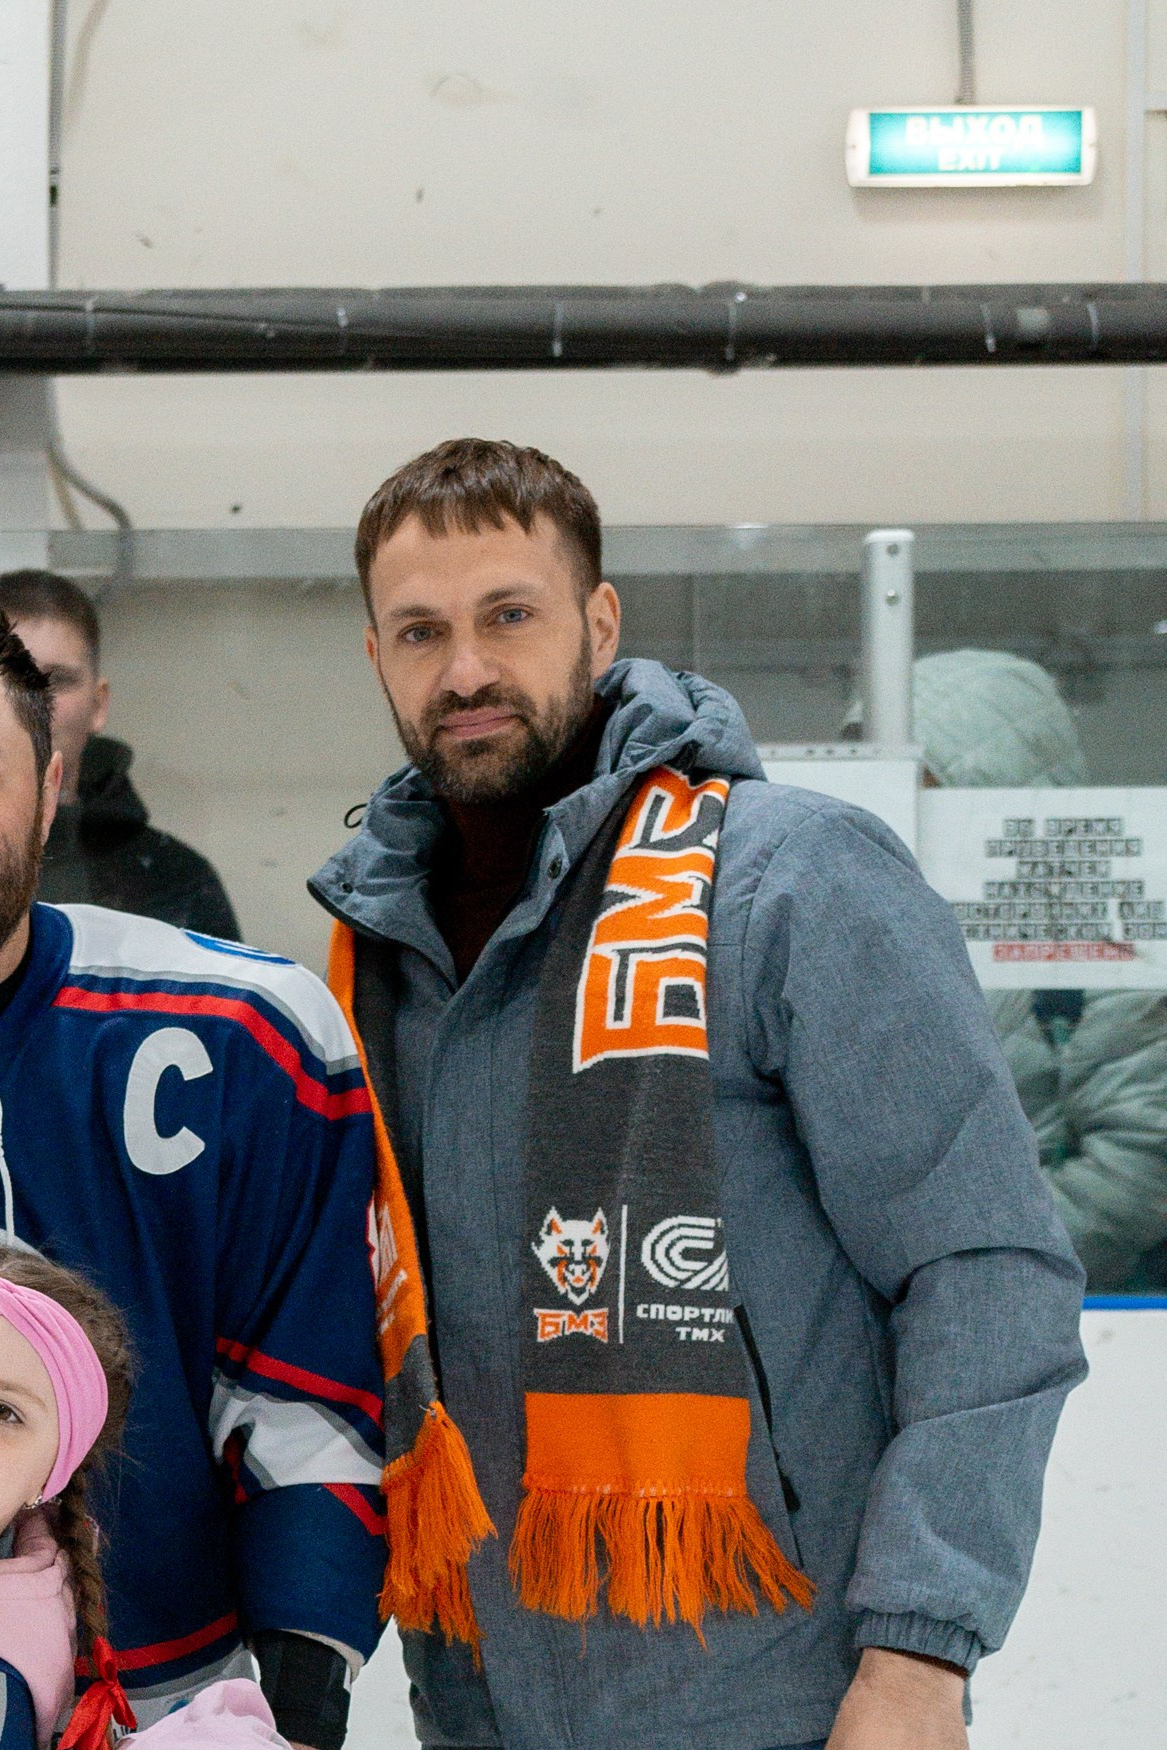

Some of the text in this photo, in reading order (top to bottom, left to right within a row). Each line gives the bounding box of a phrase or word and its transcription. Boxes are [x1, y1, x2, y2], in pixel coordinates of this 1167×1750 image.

[905, 115, 1043, 149] ВЫХОД
[937, 149, 1003, 171] EXIT
[534, 1308, 609, 1342] БМЗ
